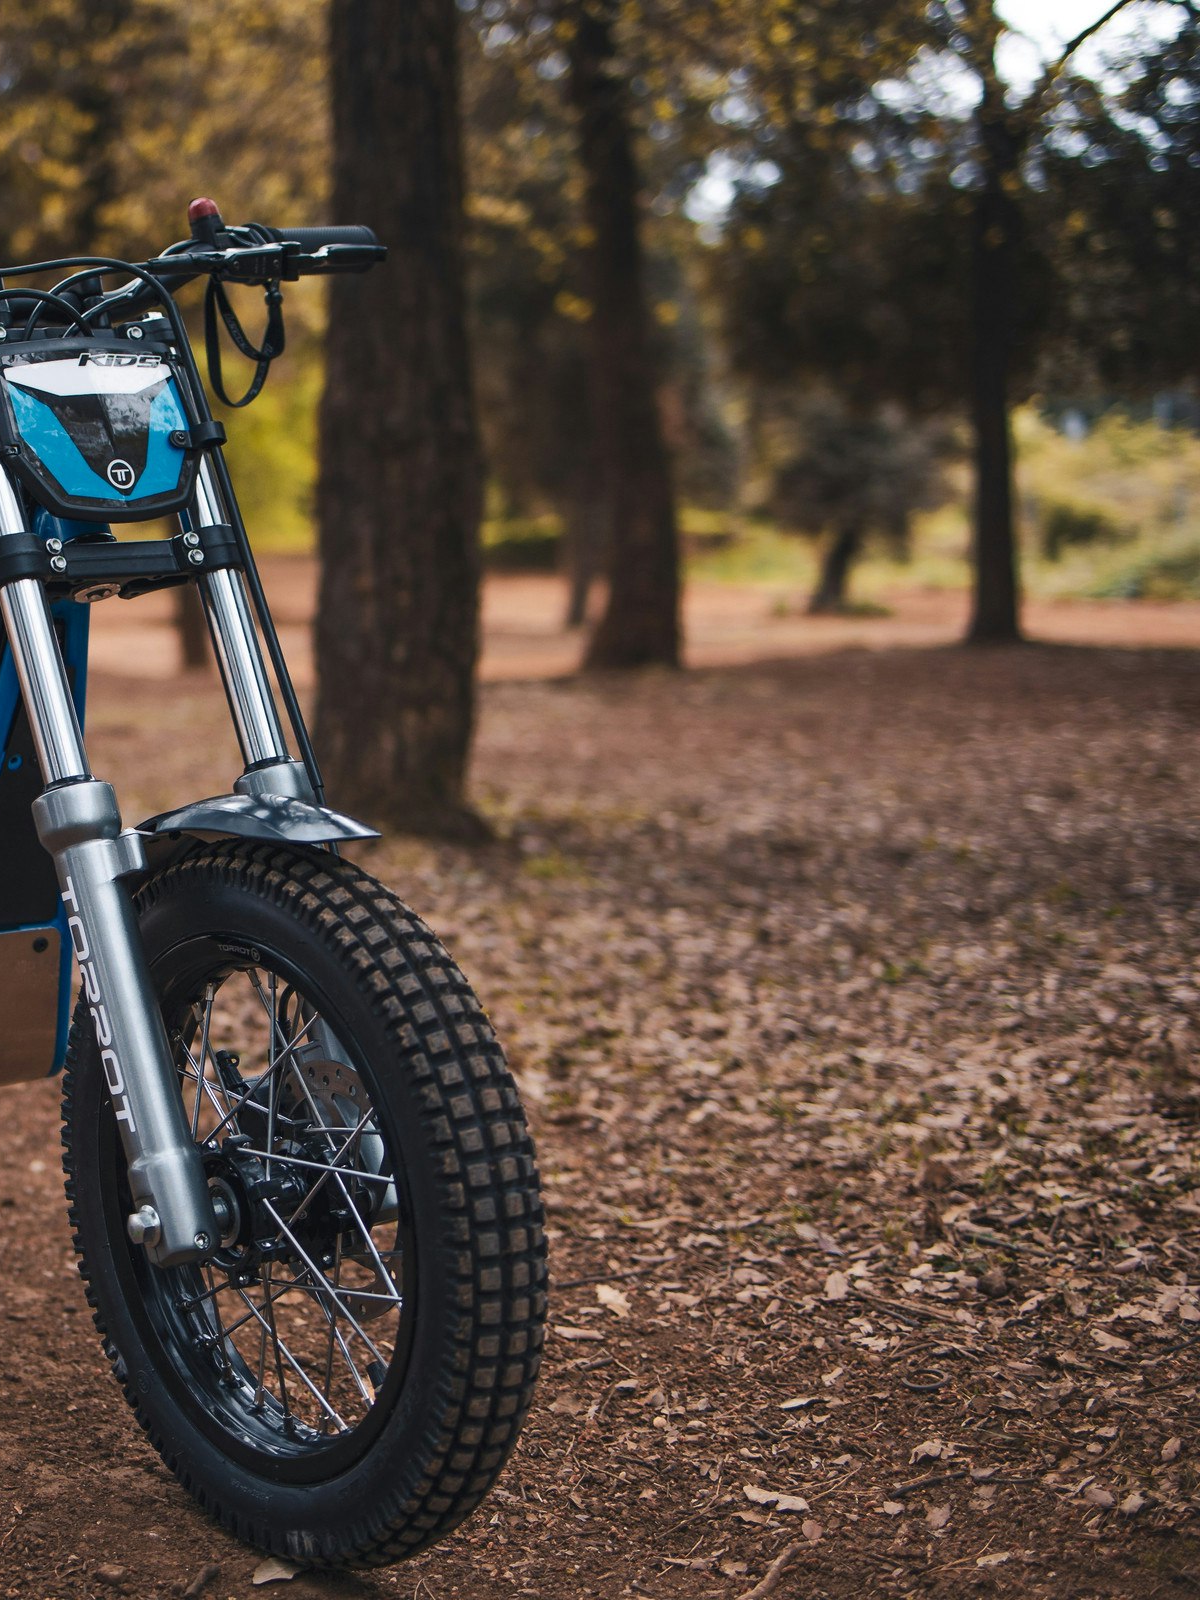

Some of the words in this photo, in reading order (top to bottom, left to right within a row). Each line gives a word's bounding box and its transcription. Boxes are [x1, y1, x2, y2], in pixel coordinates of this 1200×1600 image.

[78, 353, 161, 368] KIDS
[217, 944, 250, 955] TORROT
[61, 876, 137, 1133] TORROT
